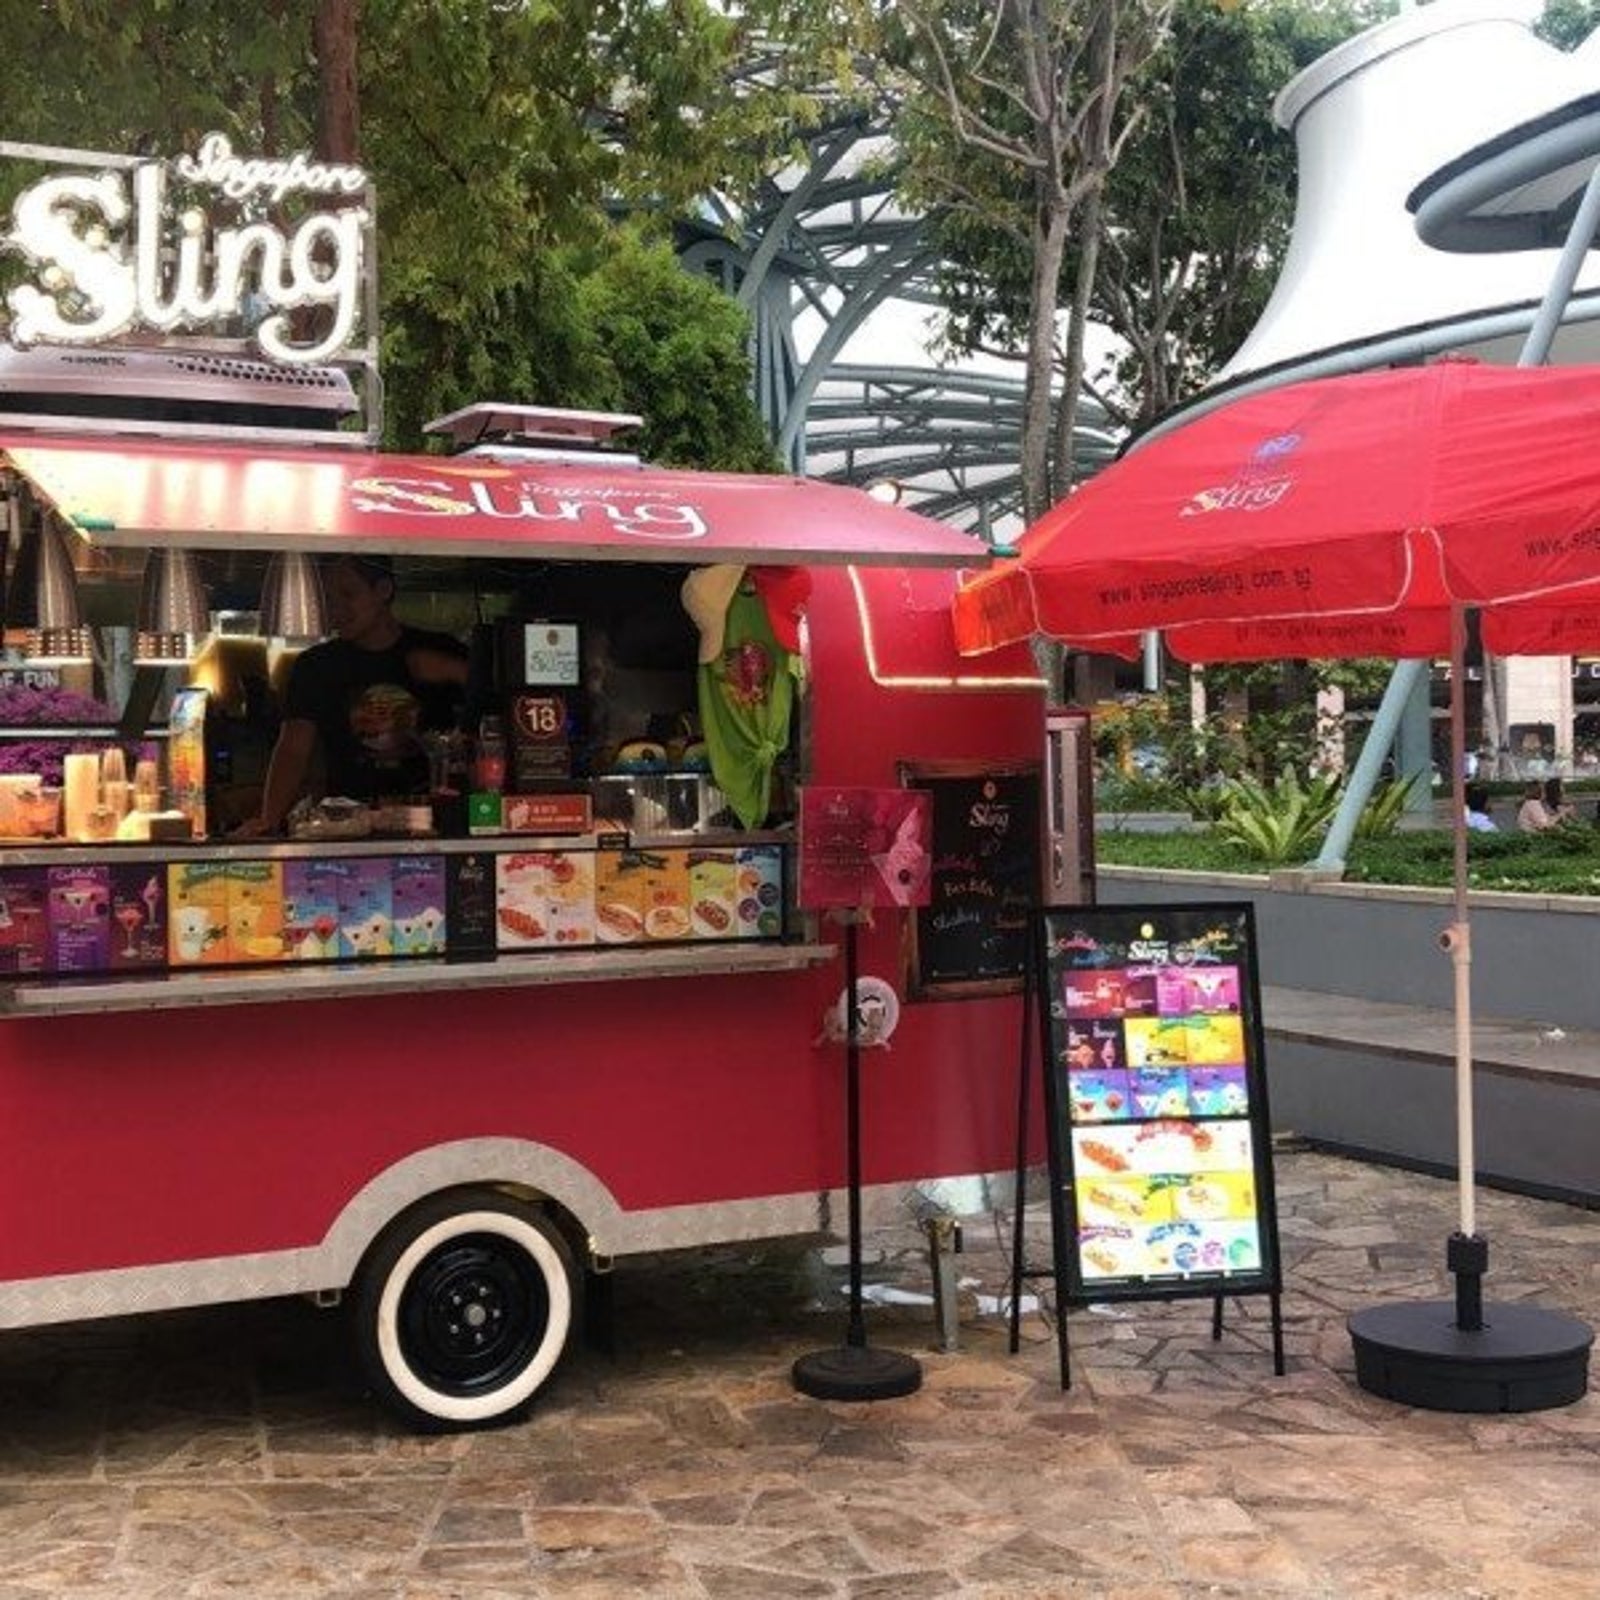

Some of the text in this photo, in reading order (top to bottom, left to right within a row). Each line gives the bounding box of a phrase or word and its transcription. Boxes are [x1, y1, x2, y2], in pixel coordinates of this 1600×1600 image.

[177, 131, 367, 200] Singapore
[2, 160, 370, 364] Sling
[351, 477, 708, 540] Sling
[1178, 480, 1292, 519] Sling
[526, 706, 556, 732] 18
